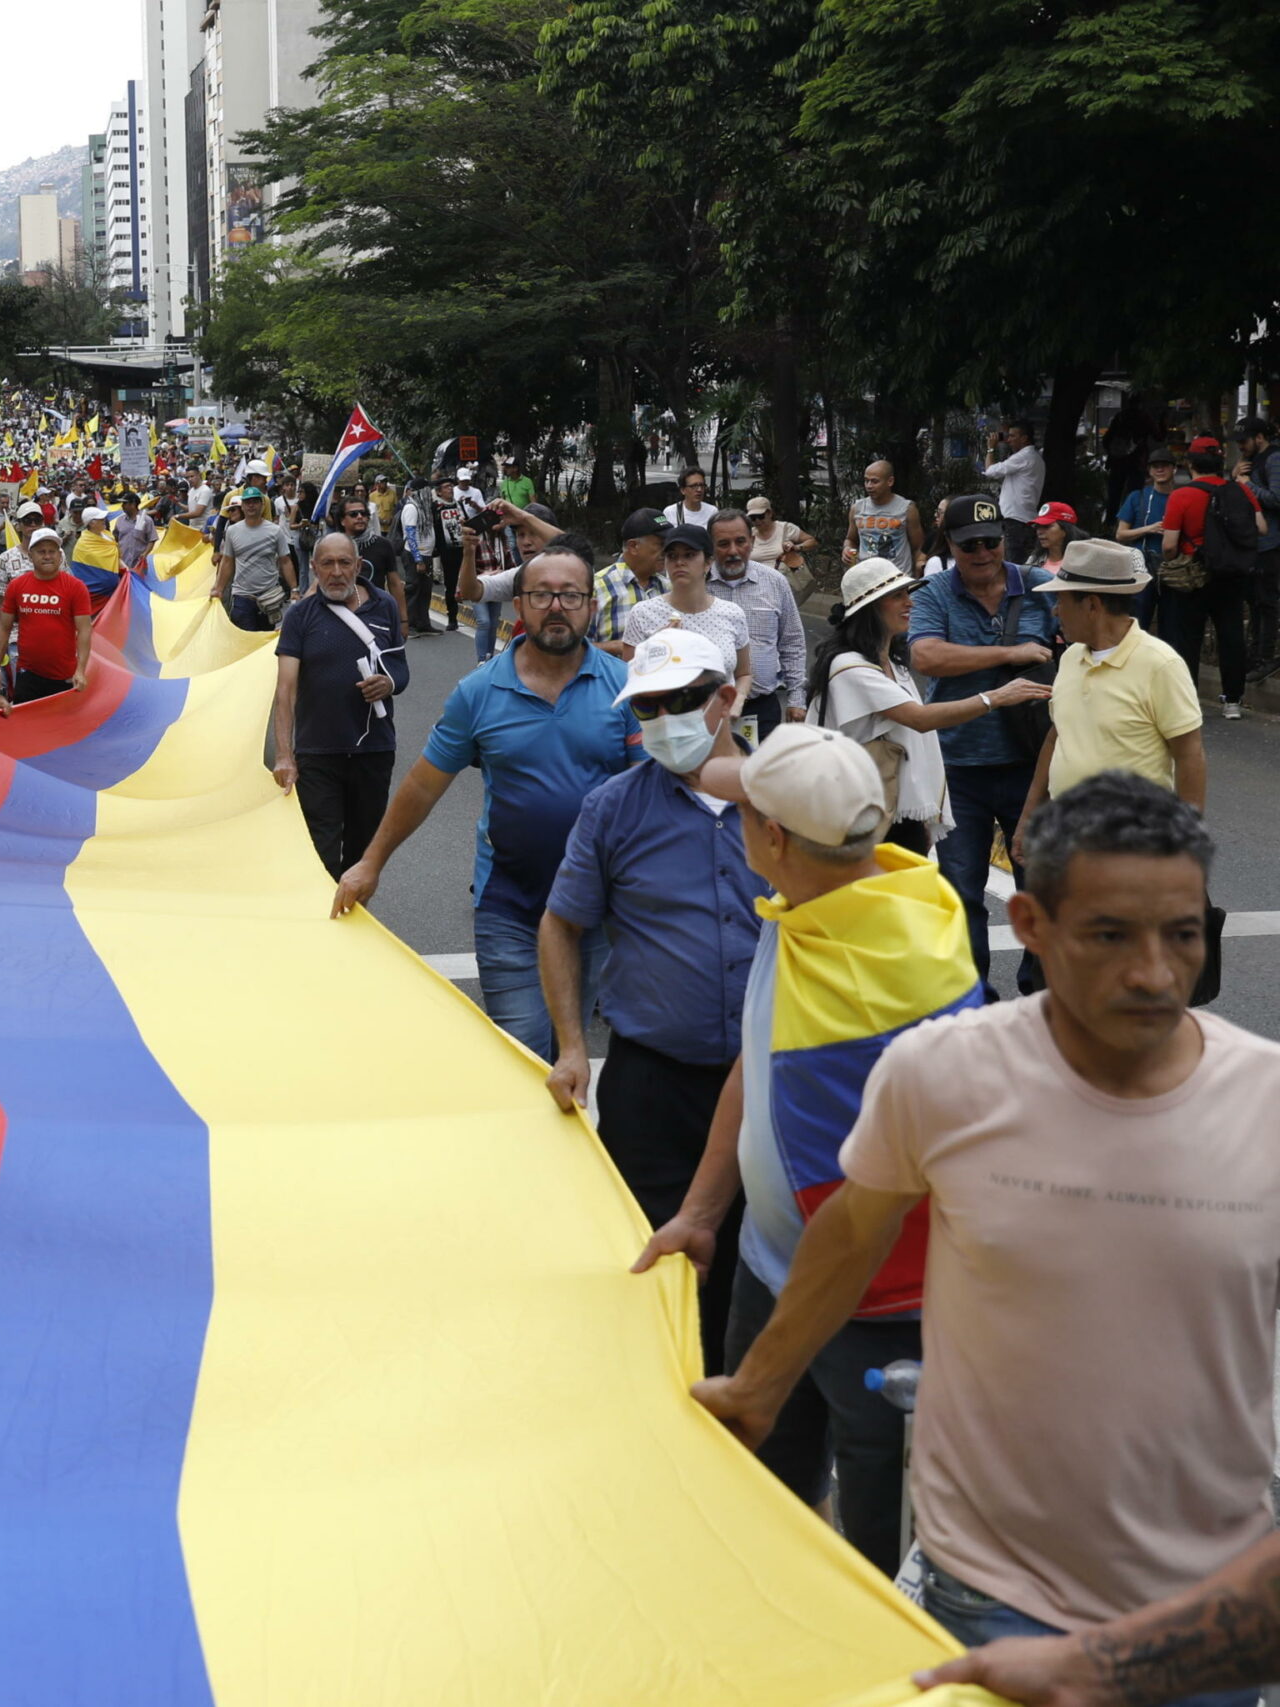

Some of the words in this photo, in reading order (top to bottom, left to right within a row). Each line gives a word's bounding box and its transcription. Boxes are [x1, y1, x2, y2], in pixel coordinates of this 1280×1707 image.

[22, 593, 59, 605] TODO
[34, 607, 61, 615] control
[989, 1171, 1043, 1193] NEVER
[1104, 1190, 1168, 1207] ALWAYS
[1174, 1198, 1264, 1214] EXPLORING
